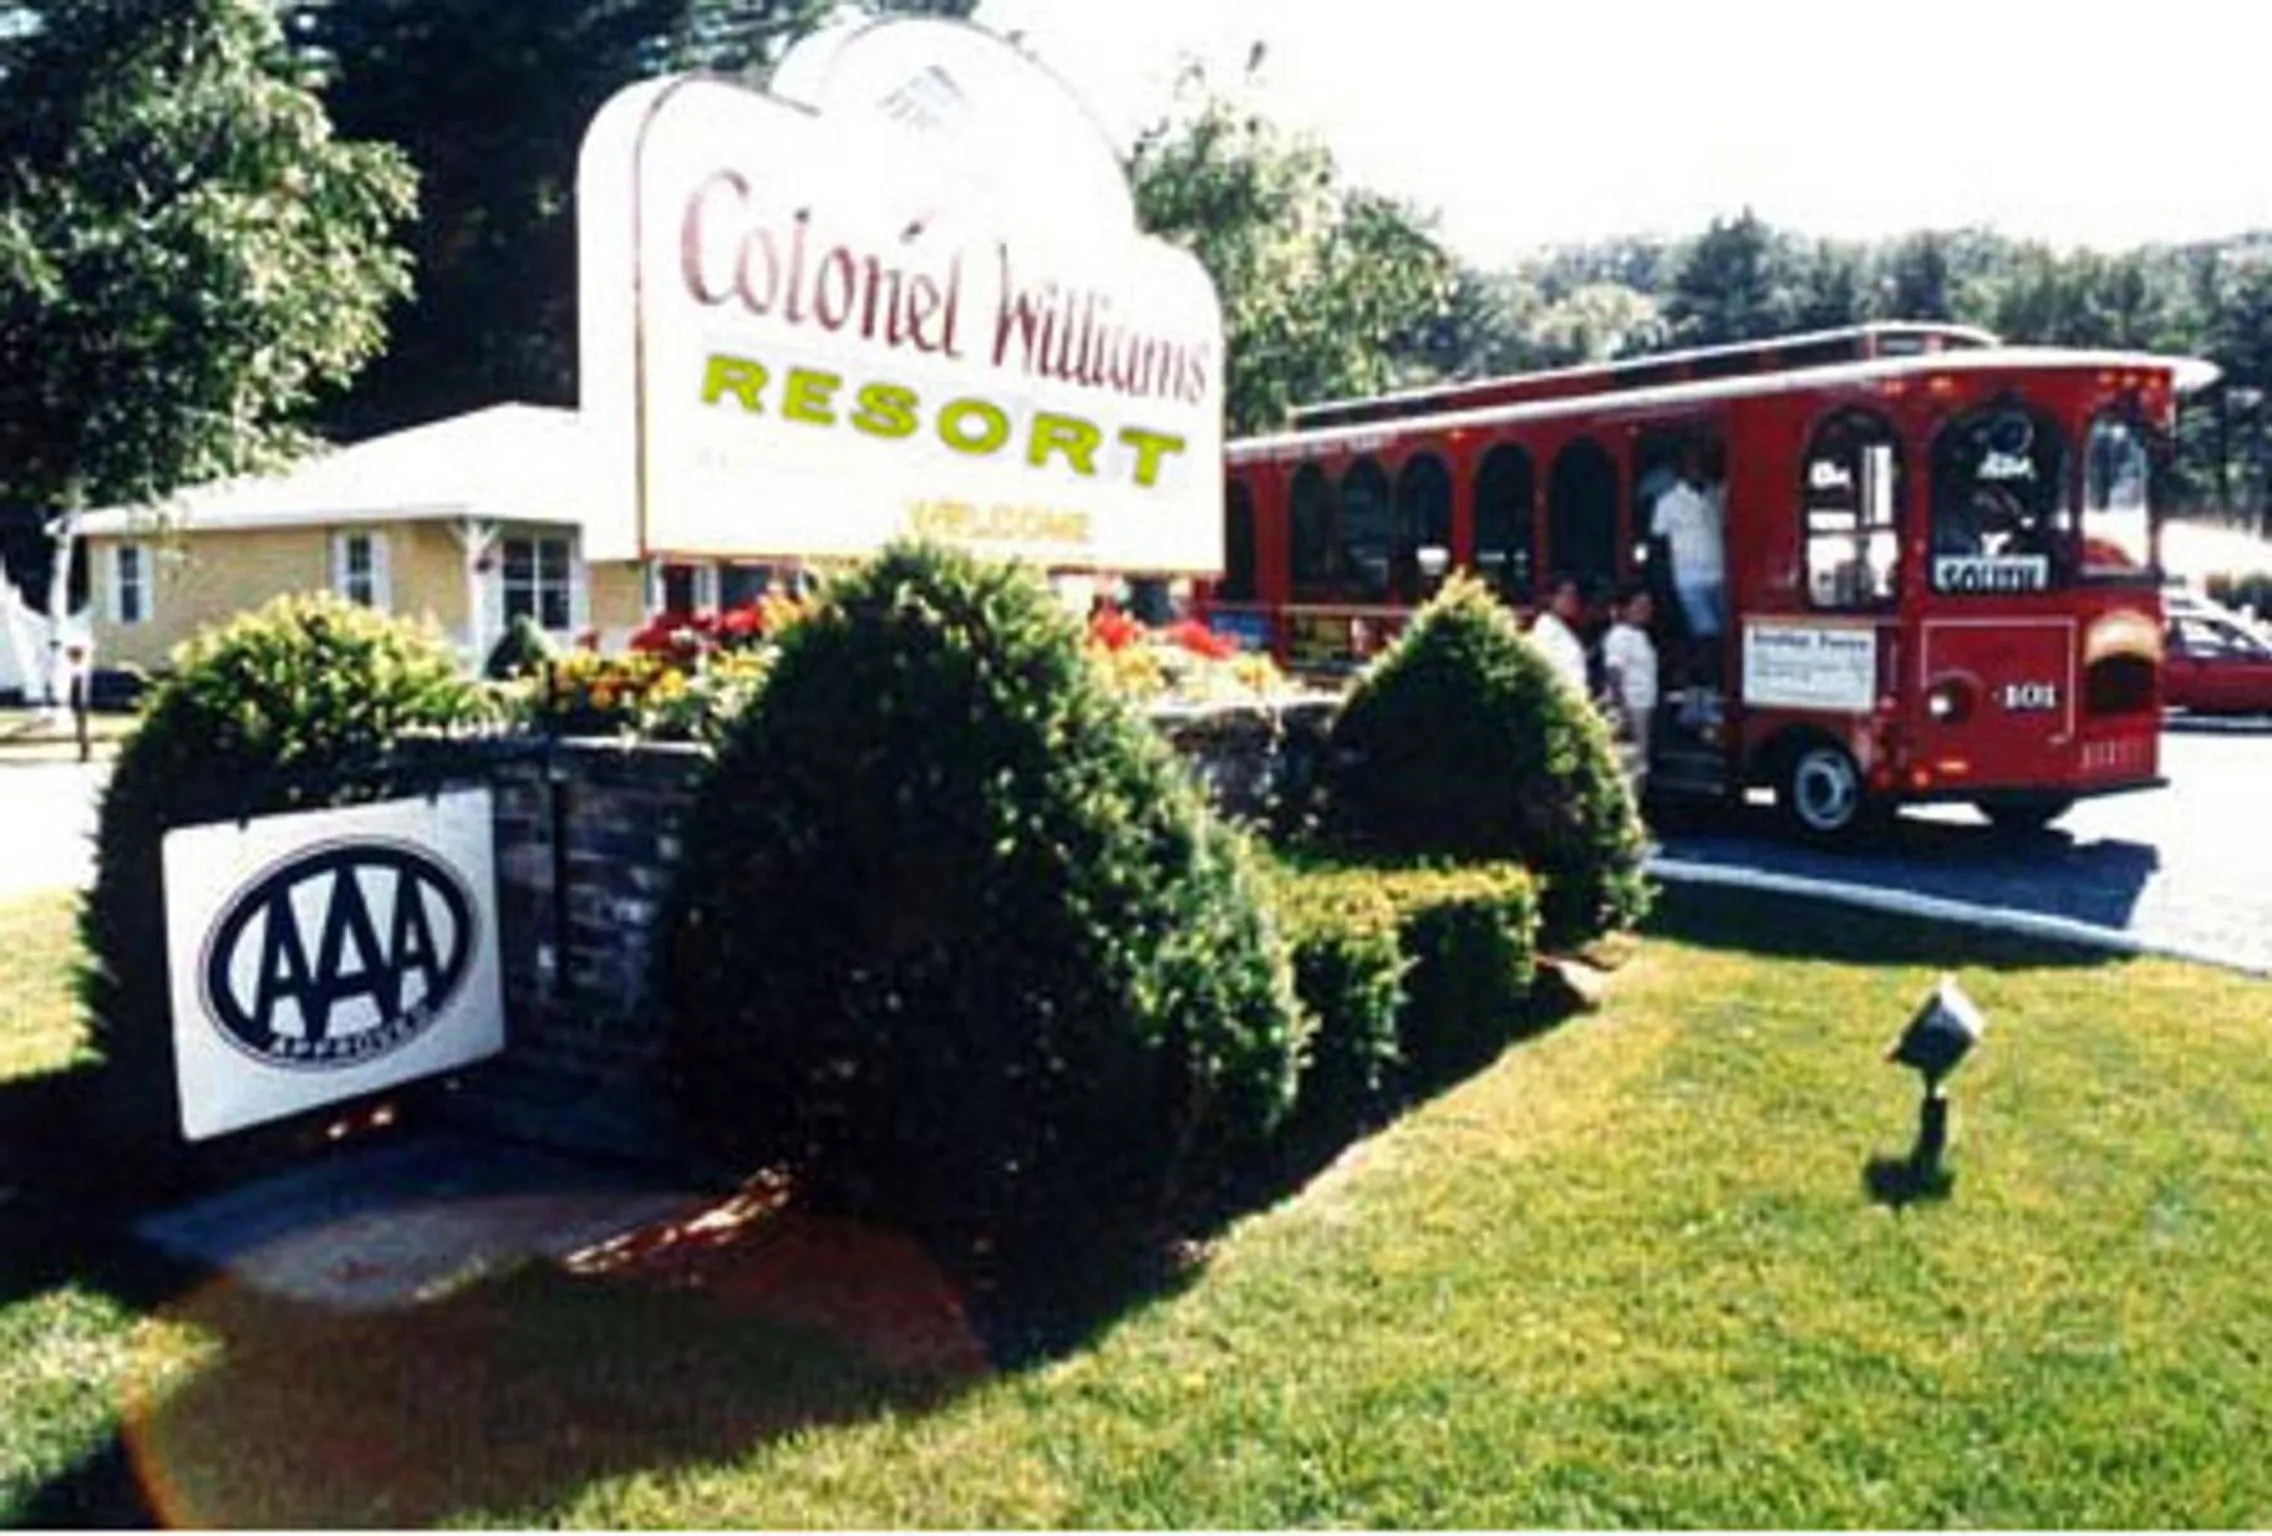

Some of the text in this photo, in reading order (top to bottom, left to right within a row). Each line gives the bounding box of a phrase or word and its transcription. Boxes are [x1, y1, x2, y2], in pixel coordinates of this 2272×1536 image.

[679, 168, 1209, 405] Colonel Williams
[699, 352, 1188, 488] RESORT
[908, 499, 1090, 543] WELCOME
[2005, 684, 2055, 708] 101
[252, 854, 448, 1046] AAA
